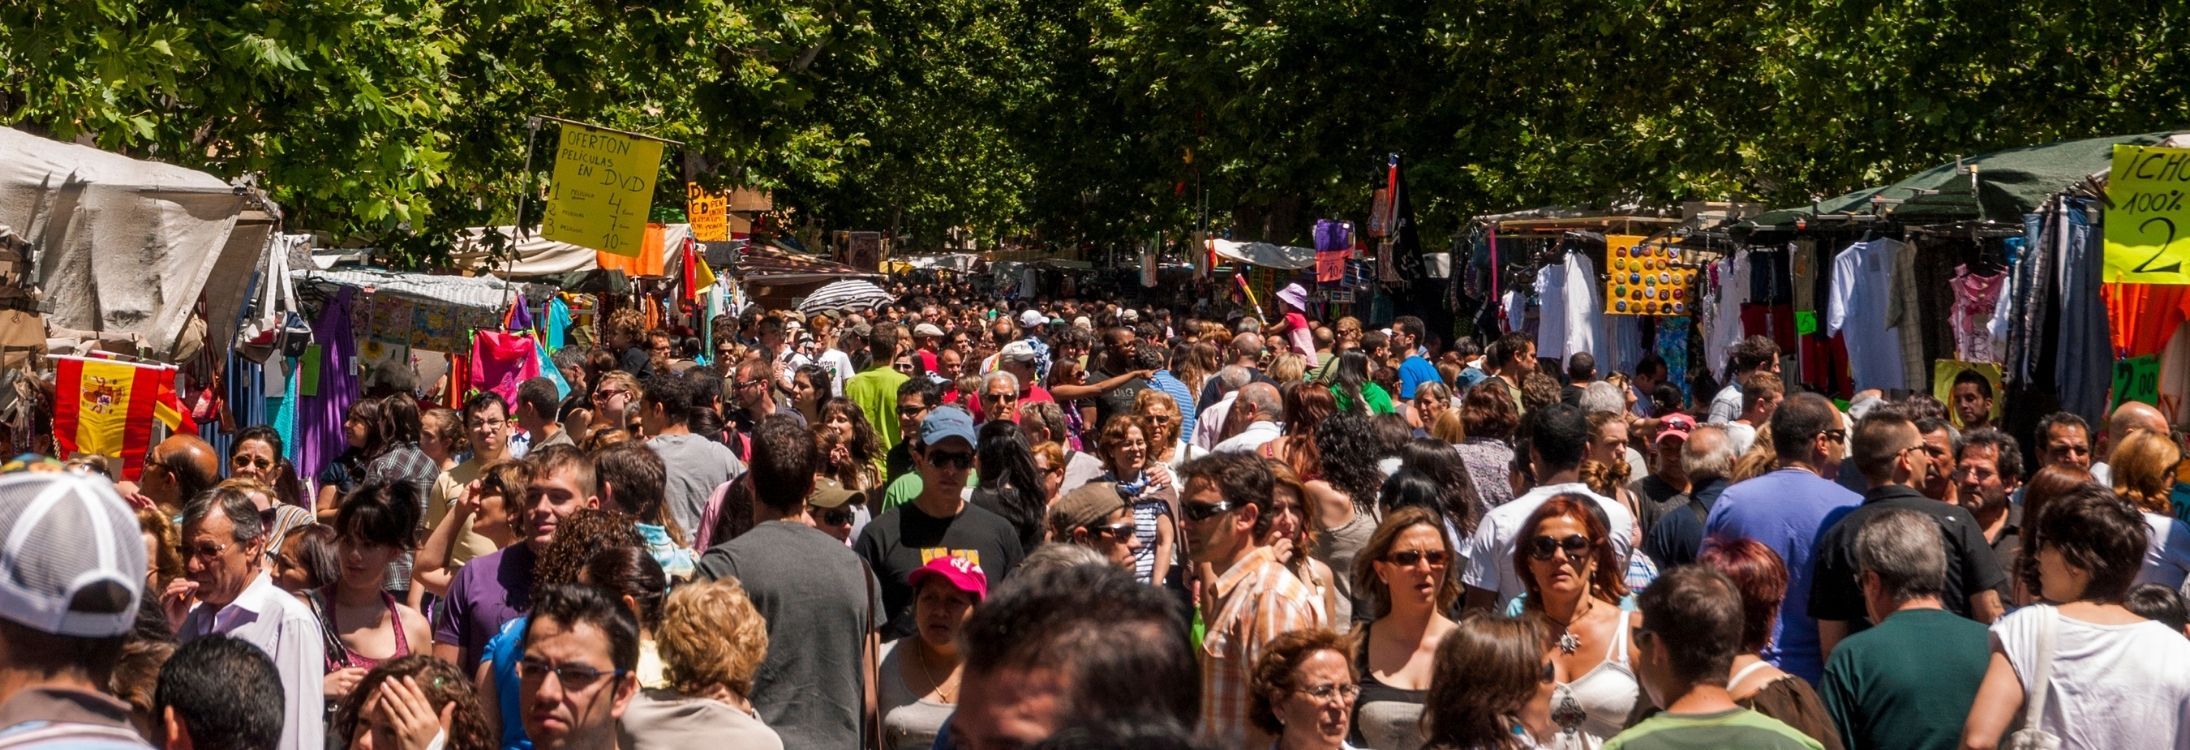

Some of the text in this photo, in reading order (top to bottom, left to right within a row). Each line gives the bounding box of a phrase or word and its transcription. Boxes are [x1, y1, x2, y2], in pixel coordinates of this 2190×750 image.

[567, 131, 630, 156] OFERTON
[578, 163, 645, 192] EN DVD
[552, 181, 560, 201] 1
[608, 192, 622, 214] 4
[691, 201, 709, 215] CD
[2121, 190, 2184, 215] 100%
[548, 202, 557, 217] 2
[608, 214, 618, 231] 7
[544, 217, 555, 236] 3
[602, 233, 619, 250] 10
[2131, 217, 2182, 273] 2
